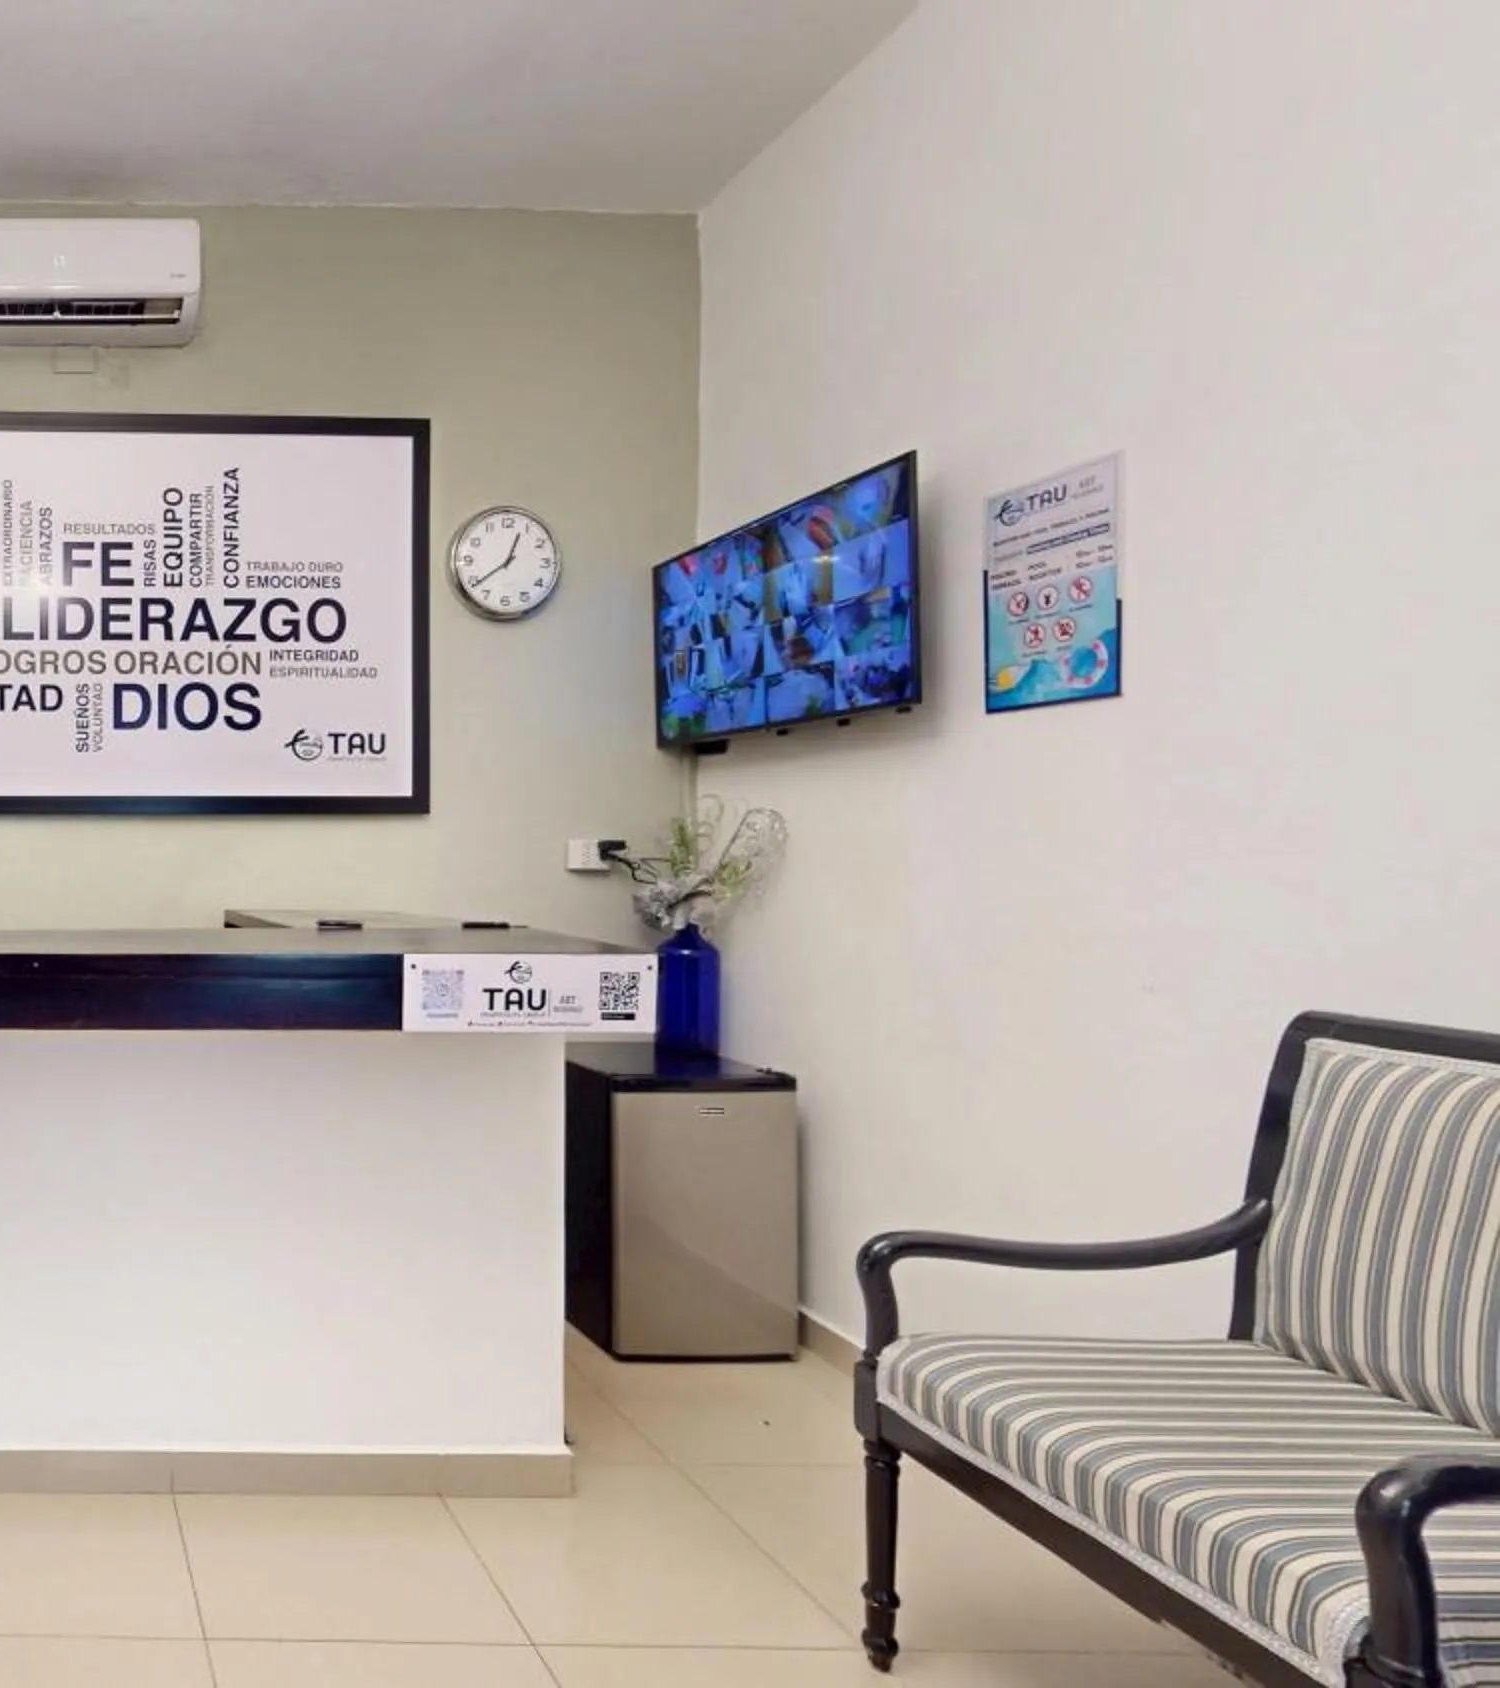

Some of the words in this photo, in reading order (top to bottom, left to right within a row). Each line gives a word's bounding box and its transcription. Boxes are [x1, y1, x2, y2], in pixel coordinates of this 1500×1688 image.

[1026, 484, 1067, 510] TAU
[63, 523, 156, 535] RESULTADOS
[223, 467, 241, 589] CONFIANZA
[501, 518, 515, 528] 12
[39, 507, 53, 586] ABRAZOS
[163, 487, 184, 588] EQUIPO
[189, 493, 203, 588] COMPARTIR
[535, 538, 545, 549] 2
[62, 541, 135, 587] FE
[144, 539, 157, 587] RISAS
[246, 561, 305, 573] TRABAJO
[308, 561, 344, 573] DURO
[463, 555, 473, 566] 9
[540, 558, 550, 569] 3
[245, 575, 341, 589] EMOCIONES
[534, 577, 543, 588] 4
[481, 589, 491, 600] 7
[500, 595, 511, 606] 6
[519, 591, 530, 602] 5
[2, 596, 347, 644] LIDERAZGO
[114, 644, 262, 675] ORACIÓN
[269, 649, 359, 662] INTEGRIDAD
[269, 667, 378, 679] ESPIRITUALIDAD
[112, 681, 262, 731] DIOS
[93, 683, 104, 752] VOLUNTAD
[327, 732, 386, 755] TAU
[482, 988, 547, 1011] TAU
